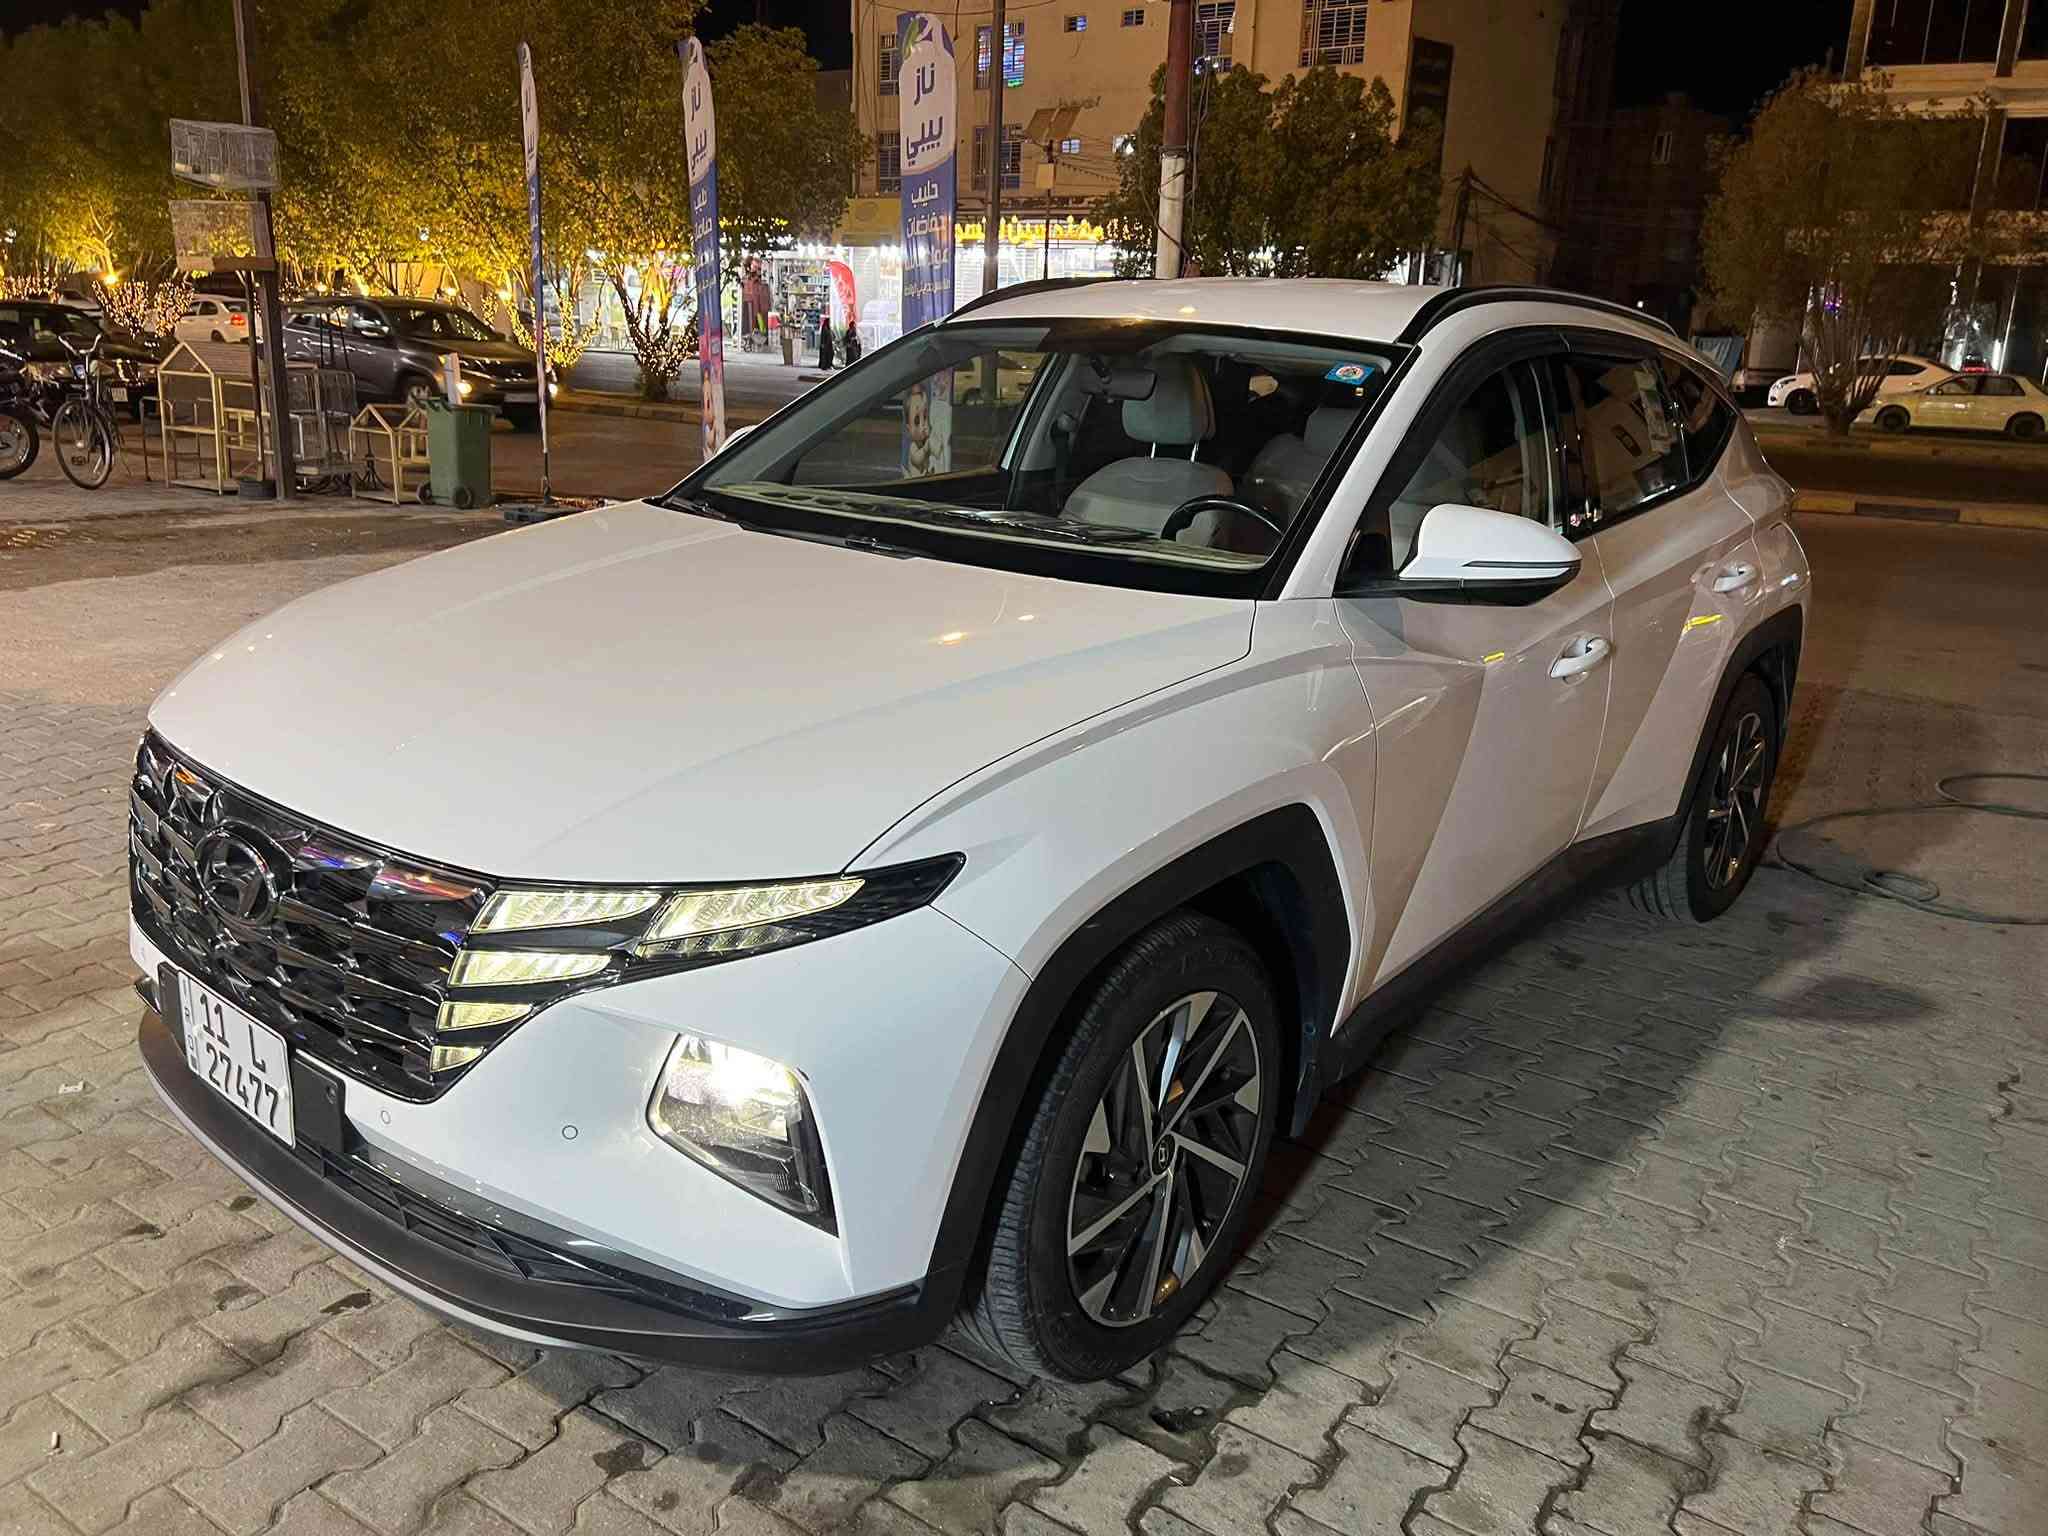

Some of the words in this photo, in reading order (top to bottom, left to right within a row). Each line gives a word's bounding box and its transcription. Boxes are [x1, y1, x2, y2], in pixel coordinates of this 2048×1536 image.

[914, 62, 935, 105] ناز
[907, 116, 943, 167] بيبي
[911, 180, 939, 208] حليب
[200, 993, 229, 1048] 11
[248, 1023, 266, 1073] L
[206, 1043, 279, 1128] 27477
